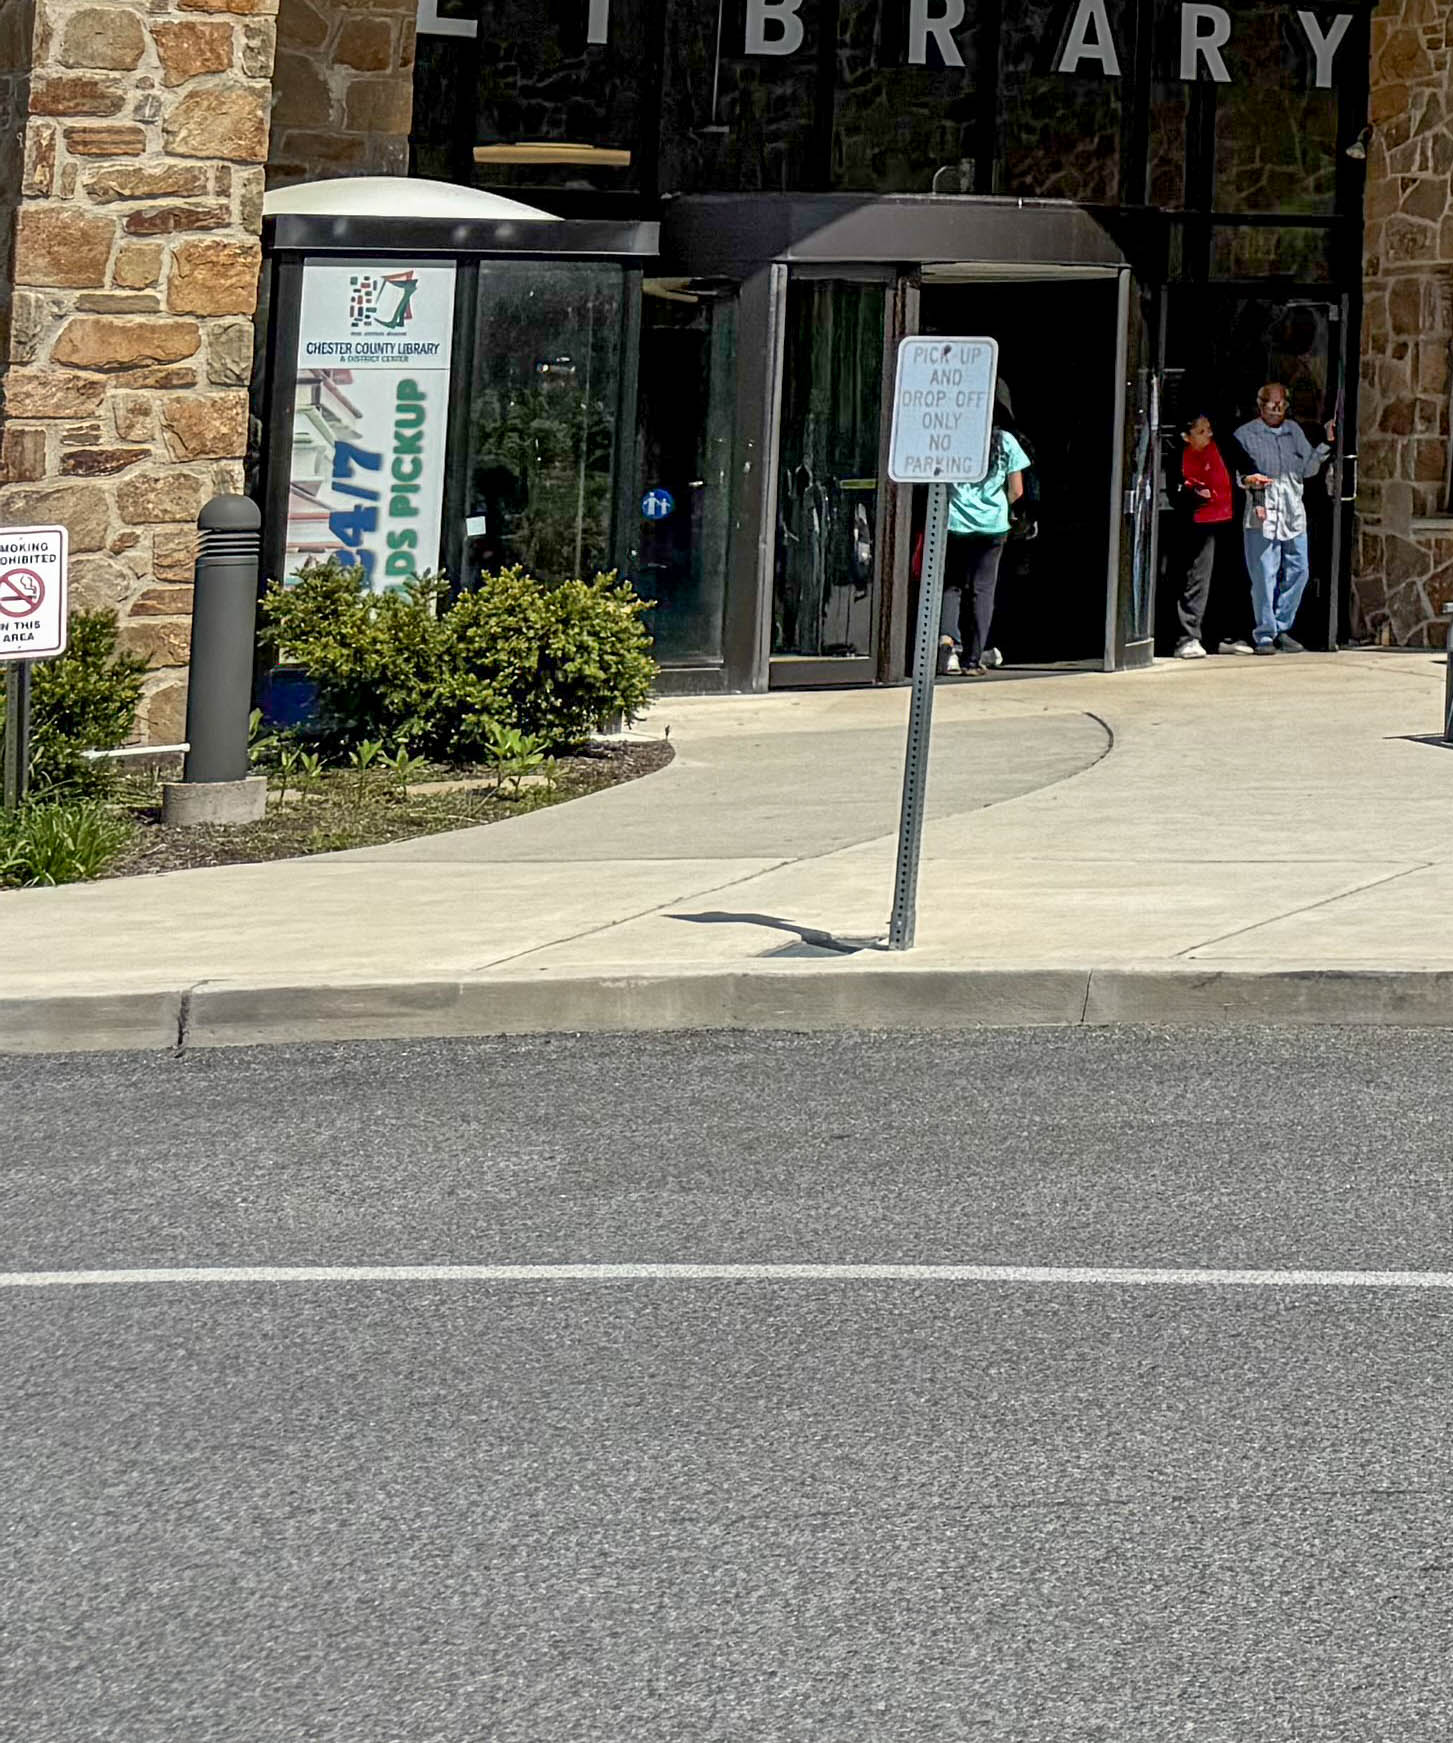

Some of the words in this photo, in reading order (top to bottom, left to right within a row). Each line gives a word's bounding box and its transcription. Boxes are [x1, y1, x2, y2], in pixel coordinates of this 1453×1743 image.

[306, 342, 353, 355] CHESTER
[355, 342, 396, 355] COUNTY
[397, 342, 441, 355] LIBRARY
[929, 368, 962, 386] AND
[922, 411, 962, 430] ONLY
[388, 378, 427, 518] PICKUP
[928, 434, 952, 452] NO
[904, 456, 973, 474] PARKING
[0, 542, 49, 553] MOKING
[0, 554, 57, 566] OHIBITED
[0, 622, 9, 631] N
[14, 620, 41, 630] THIS
[3, 632, 35, 643] AREA
